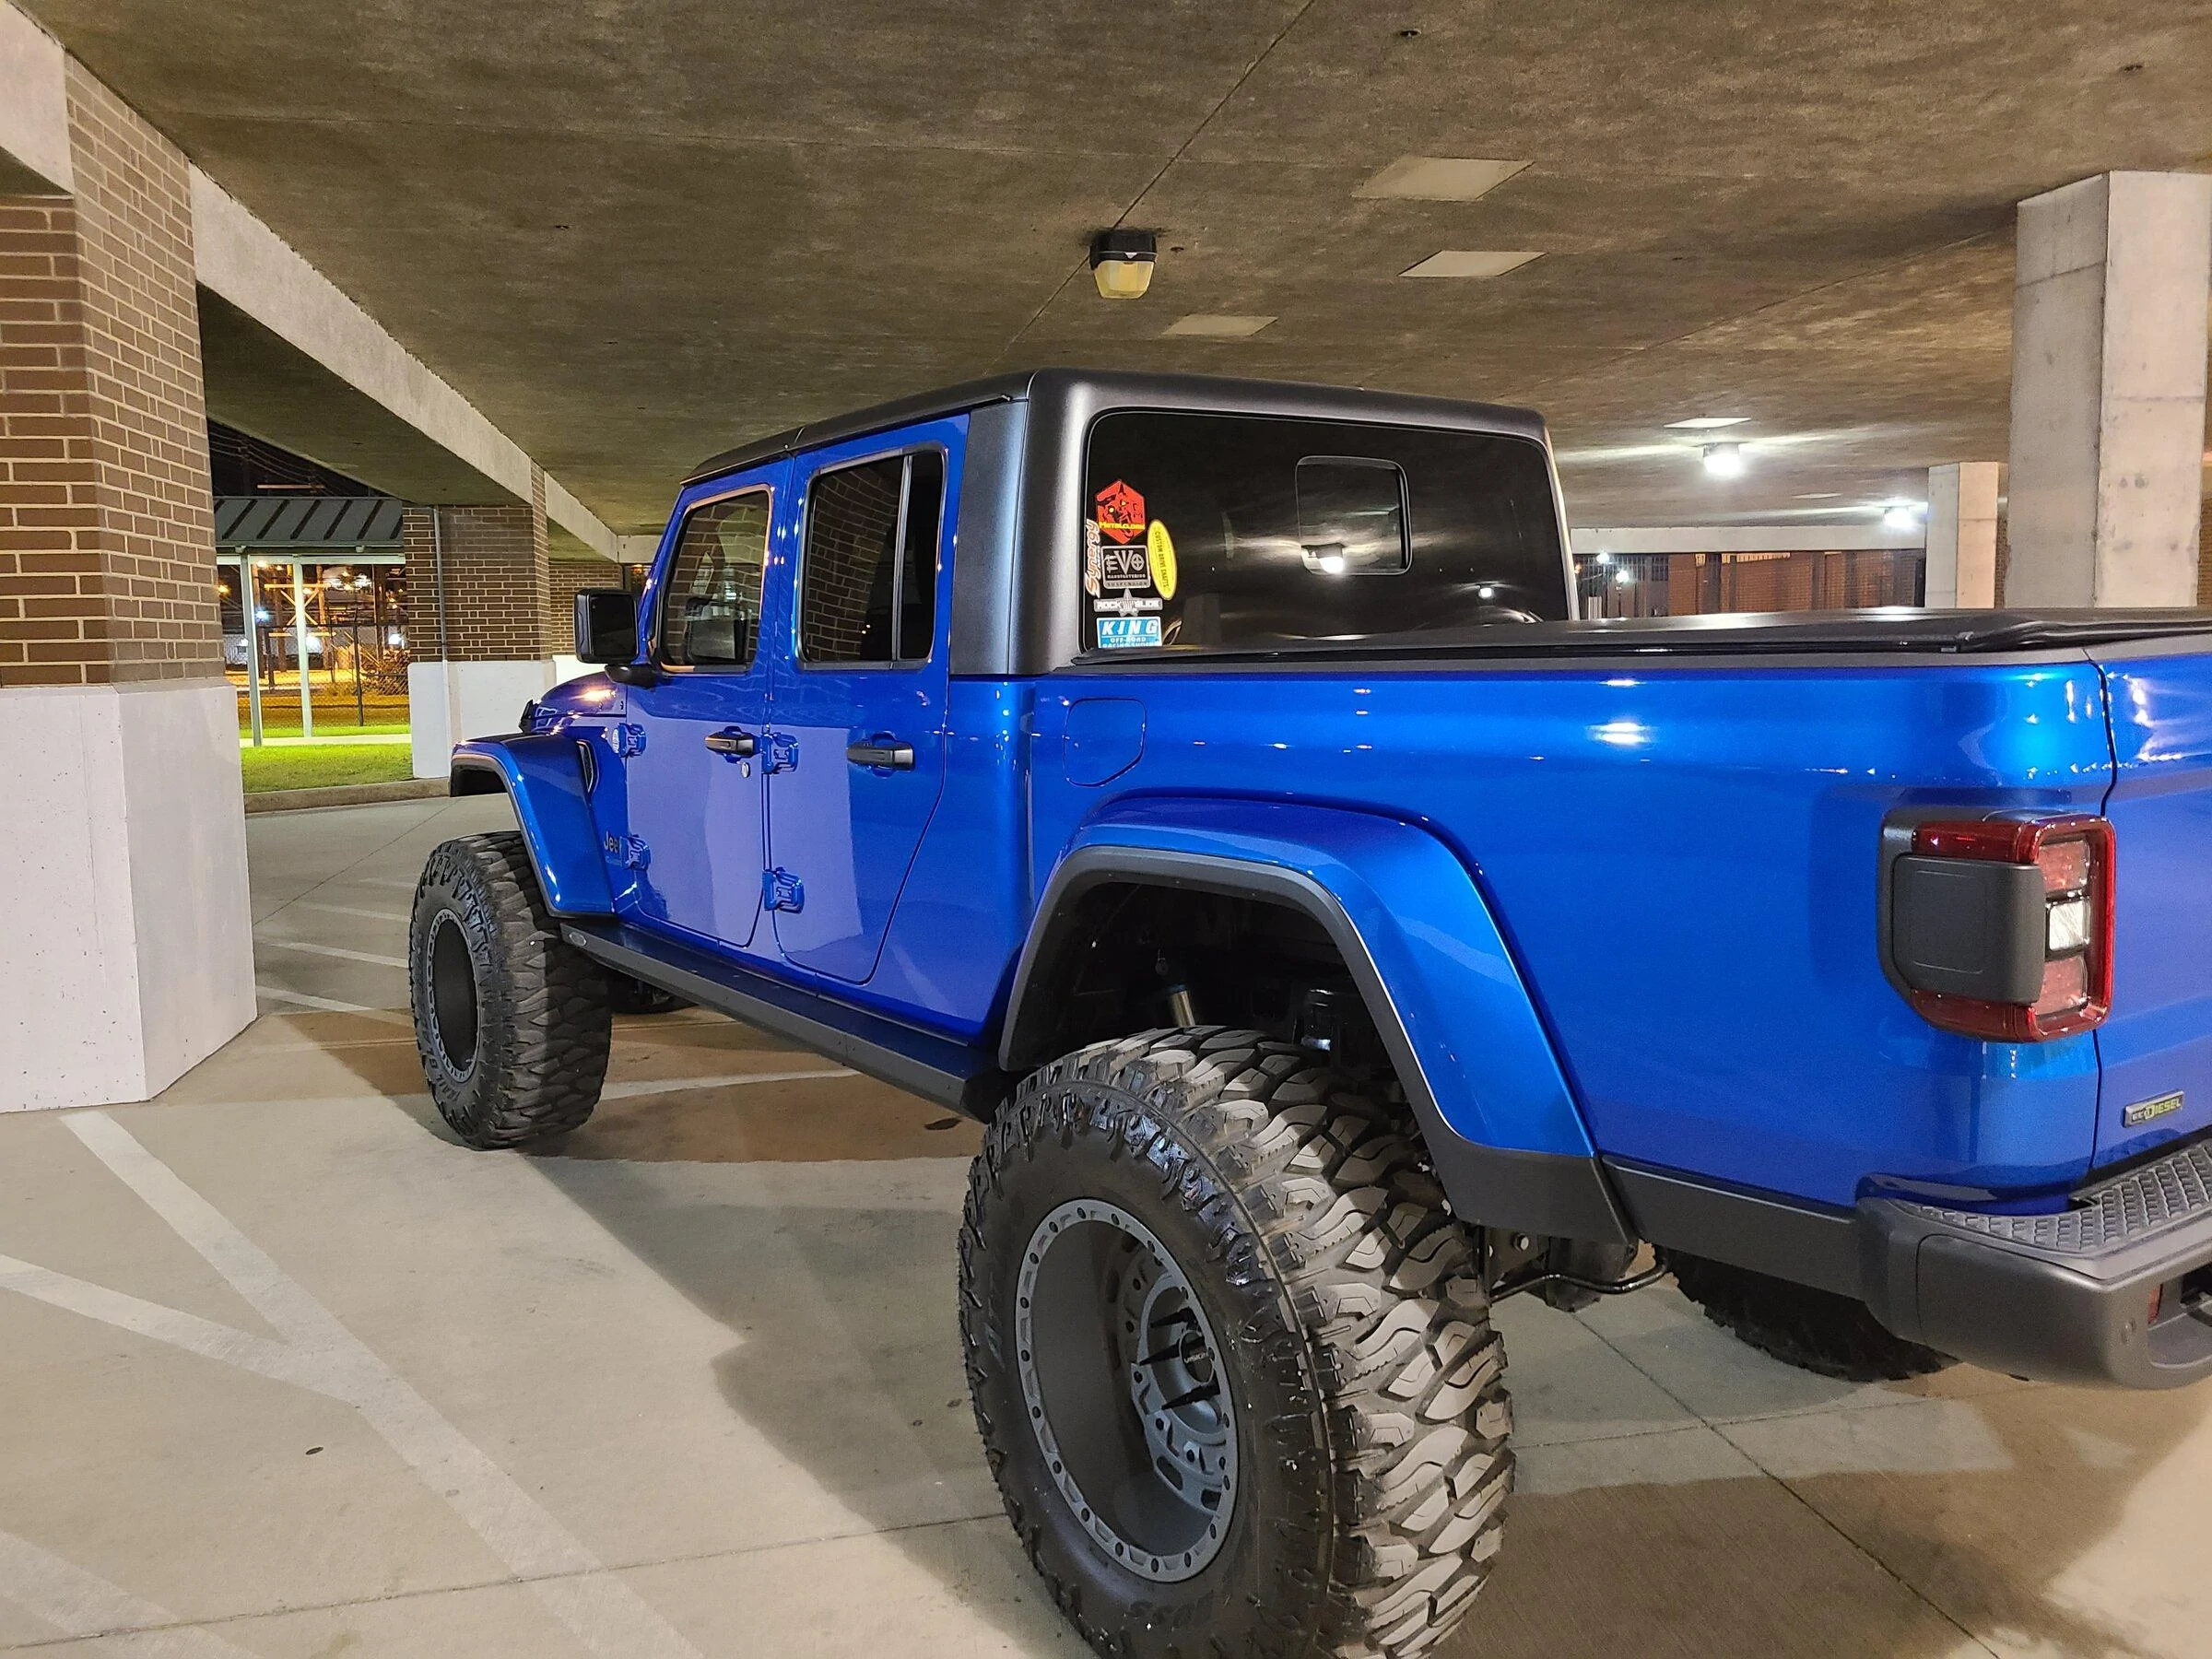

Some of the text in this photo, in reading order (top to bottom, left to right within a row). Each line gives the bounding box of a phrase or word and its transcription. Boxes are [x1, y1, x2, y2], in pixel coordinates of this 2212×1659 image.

[1155, 531, 1164, 552] CUSTOM
[1085, 519, 1100, 598] Synergy
[1104, 549, 1145, 575] EVO
[1097, 601, 1123, 609] ROCK
[1101, 619, 1158, 636] KING
[603, 830, 620, 853] Jee
